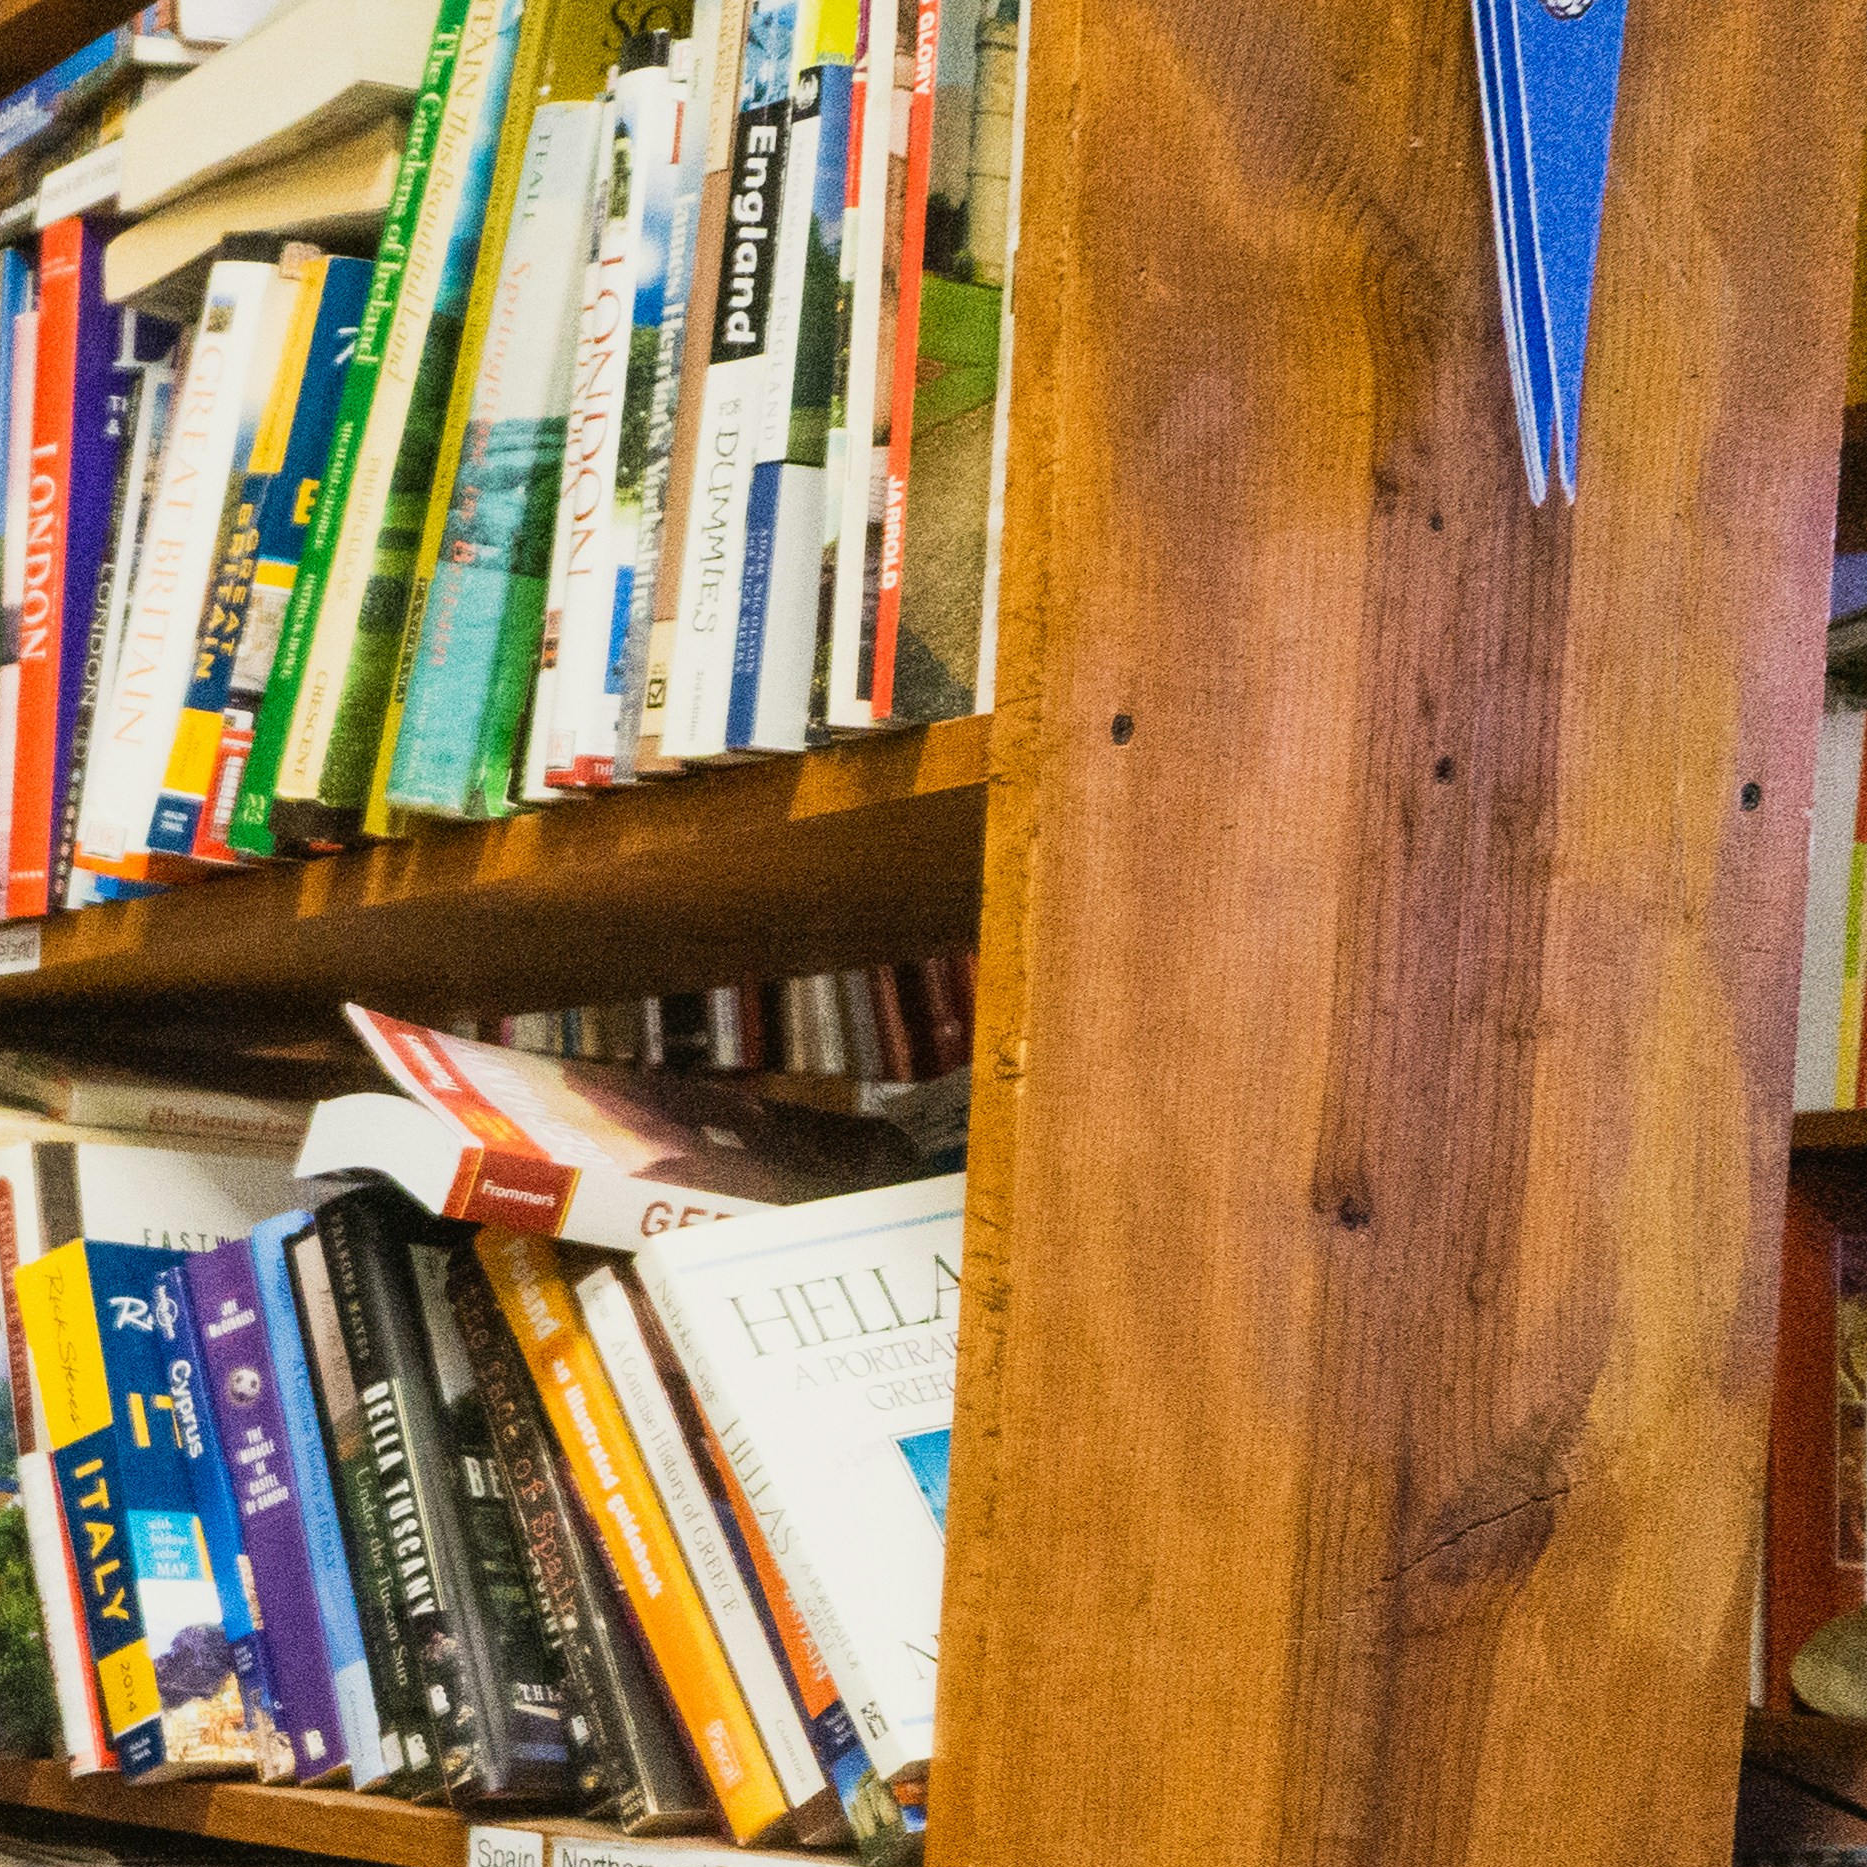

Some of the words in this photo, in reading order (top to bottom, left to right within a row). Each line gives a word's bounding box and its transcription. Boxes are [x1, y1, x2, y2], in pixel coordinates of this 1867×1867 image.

[430, 22, 471, 92] The
[914, 12, 936, 94] GLORY
[398, 90, 454, 224] Gardens
[434, 106, 471, 168] This
[388, 223, 422, 261] of
[401, 165, 457, 302] Beautiful
[660, 195, 698, 296] James
[727, 125, 777, 344] England
[360, 260, 412, 371] Ireland
[381, 300, 424, 385] Land
[462, 255, 538, 472] Springtime
[568, 252, 626, 577] LONDON
[641, 297, 686, 442] Herriot's
[757, 293, 795, 445] ENGLAND
[158, 341, 232, 528] GREAT
[21, 443, 57, 659] LONDON
[458, 482, 489, 525] in
[622, 450, 669, 623] Yorkshire
[692, 427, 738, 634] DUMMIES
[753, 525, 773, 577] ADAM
[879, 474, 908, 590] JARROLD
[78, 561, 119, 711] LONDON
[111, 534, 190, 749] BRITAIN
[195, 502, 254, 680] BRITAIN
[301, 573, 329, 633] PATRICK
[426, 537, 478, 669] Britain
[291, 668, 332, 783] CRESCENT
[481, 1180, 556, 1208] Frommer's
[41, 1268, 74, 1333] Rick
[323, 1211, 362, 1297] FRANCES
[344, 1300, 376, 1360] MAYES
[649, 1279, 700, 1360] Nicholas
[171, 1358, 202, 1459] Cyprus
[352, 1379, 414, 1475] BELLA
[615, 1354, 665, 1433] Concise
[795, 1362, 819, 1391] A
[349, 1466, 385, 1535] Under
[511, 1454, 552, 1509] of
[555, 1382, 625, 1492] illustrated
[601, 1489, 671, 1600] guidebook
[644, 1430, 695, 1505] History
[677, 1500, 703, 1525] of
[711, 1417, 805, 1558] HELLAS
[74, 1457, 130, 1622] ITALY
[365, 1535, 391, 1571] the
[375, 1476, 452, 1618] TUSCANY
[521, 1508, 589, 1623] Spain
[687, 1523, 743, 1618] GREECE
[372, 1573, 407, 1643] Tuscan
[802, 1575, 856, 1649] PORTRAIT
[118, 1661, 140, 1714] 2014
[386, 1645, 414, 1689] Sun
[697, 1719, 749, 1787] Pascal
